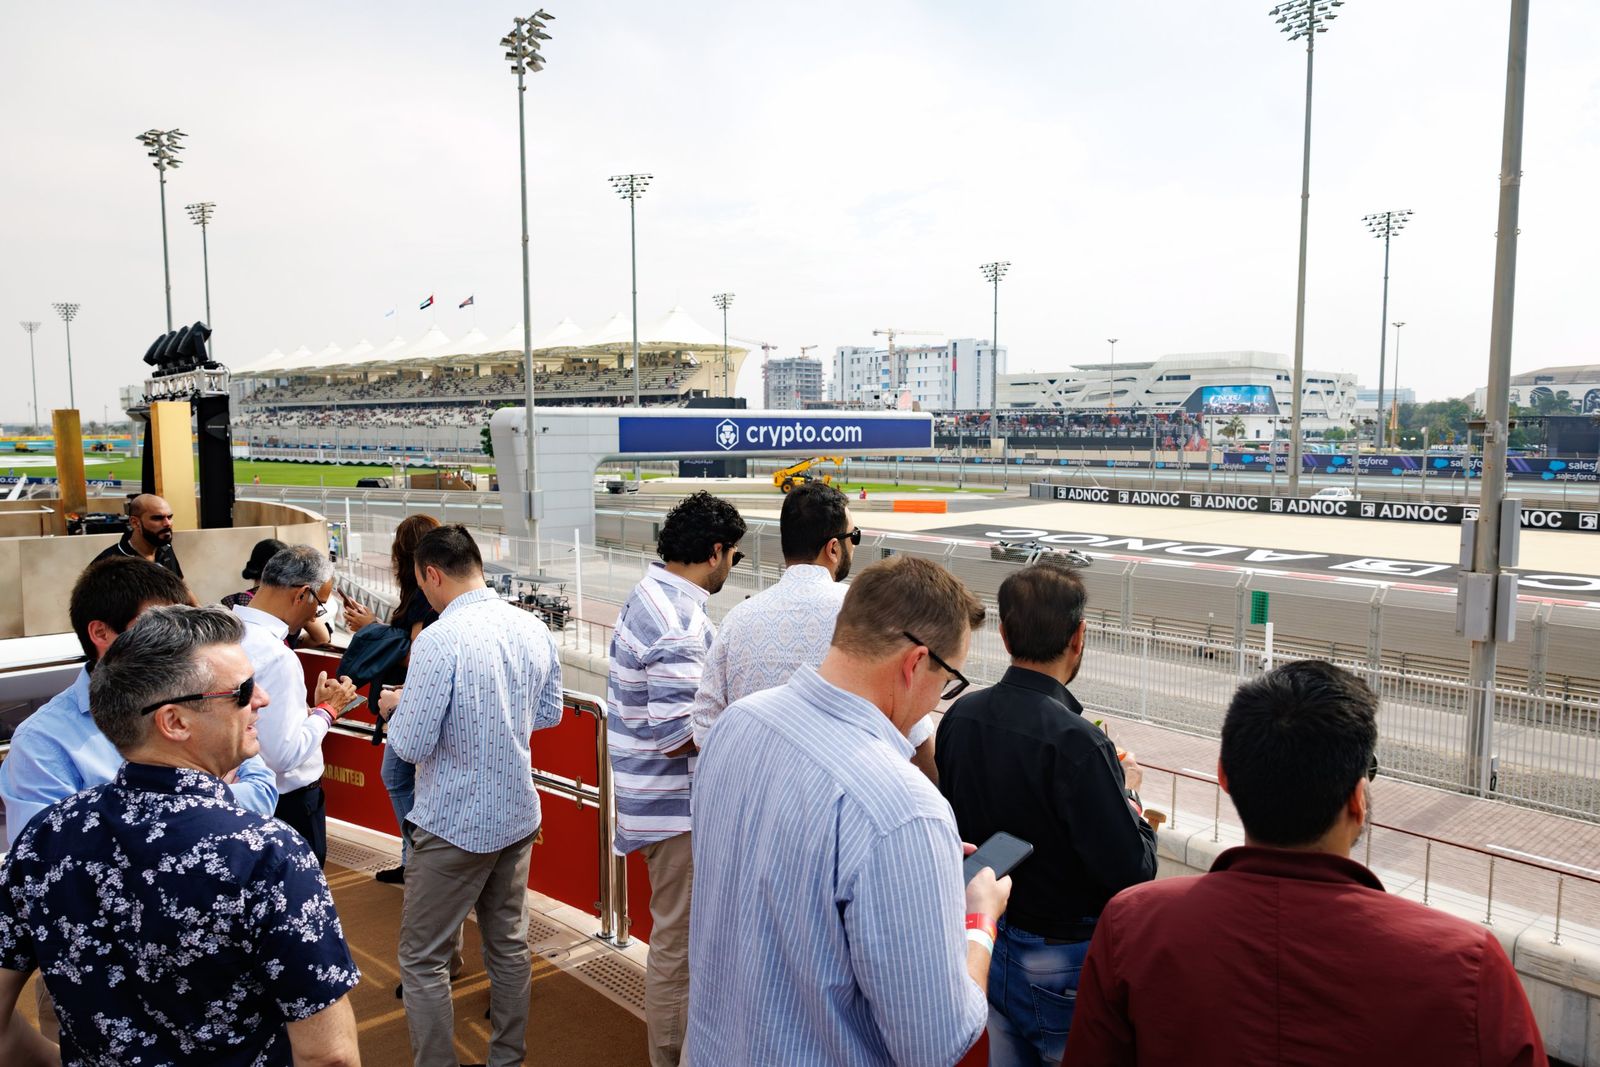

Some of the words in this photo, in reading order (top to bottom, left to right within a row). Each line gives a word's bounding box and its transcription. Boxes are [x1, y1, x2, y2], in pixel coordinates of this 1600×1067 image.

[746, 422, 862, 447] crypto.com
[1347, 457, 1388, 467] sesforce
[1337, 467, 1369, 475] salesfrce
[1556, 473, 1597, 481] salesforce
[1068, 487, 1109, 502] ADNOC
[1131, 492, 1180, 506] ADNOC
[1204, 496, 1258, 511] ADNOC
[1287, 499, 1347, 515] ADNOC
[1379, 504, 1448, 521] ADNOC
[1520, 510, 1562, 528] NOC
[323, 764, 365, 787] ARANTEED
